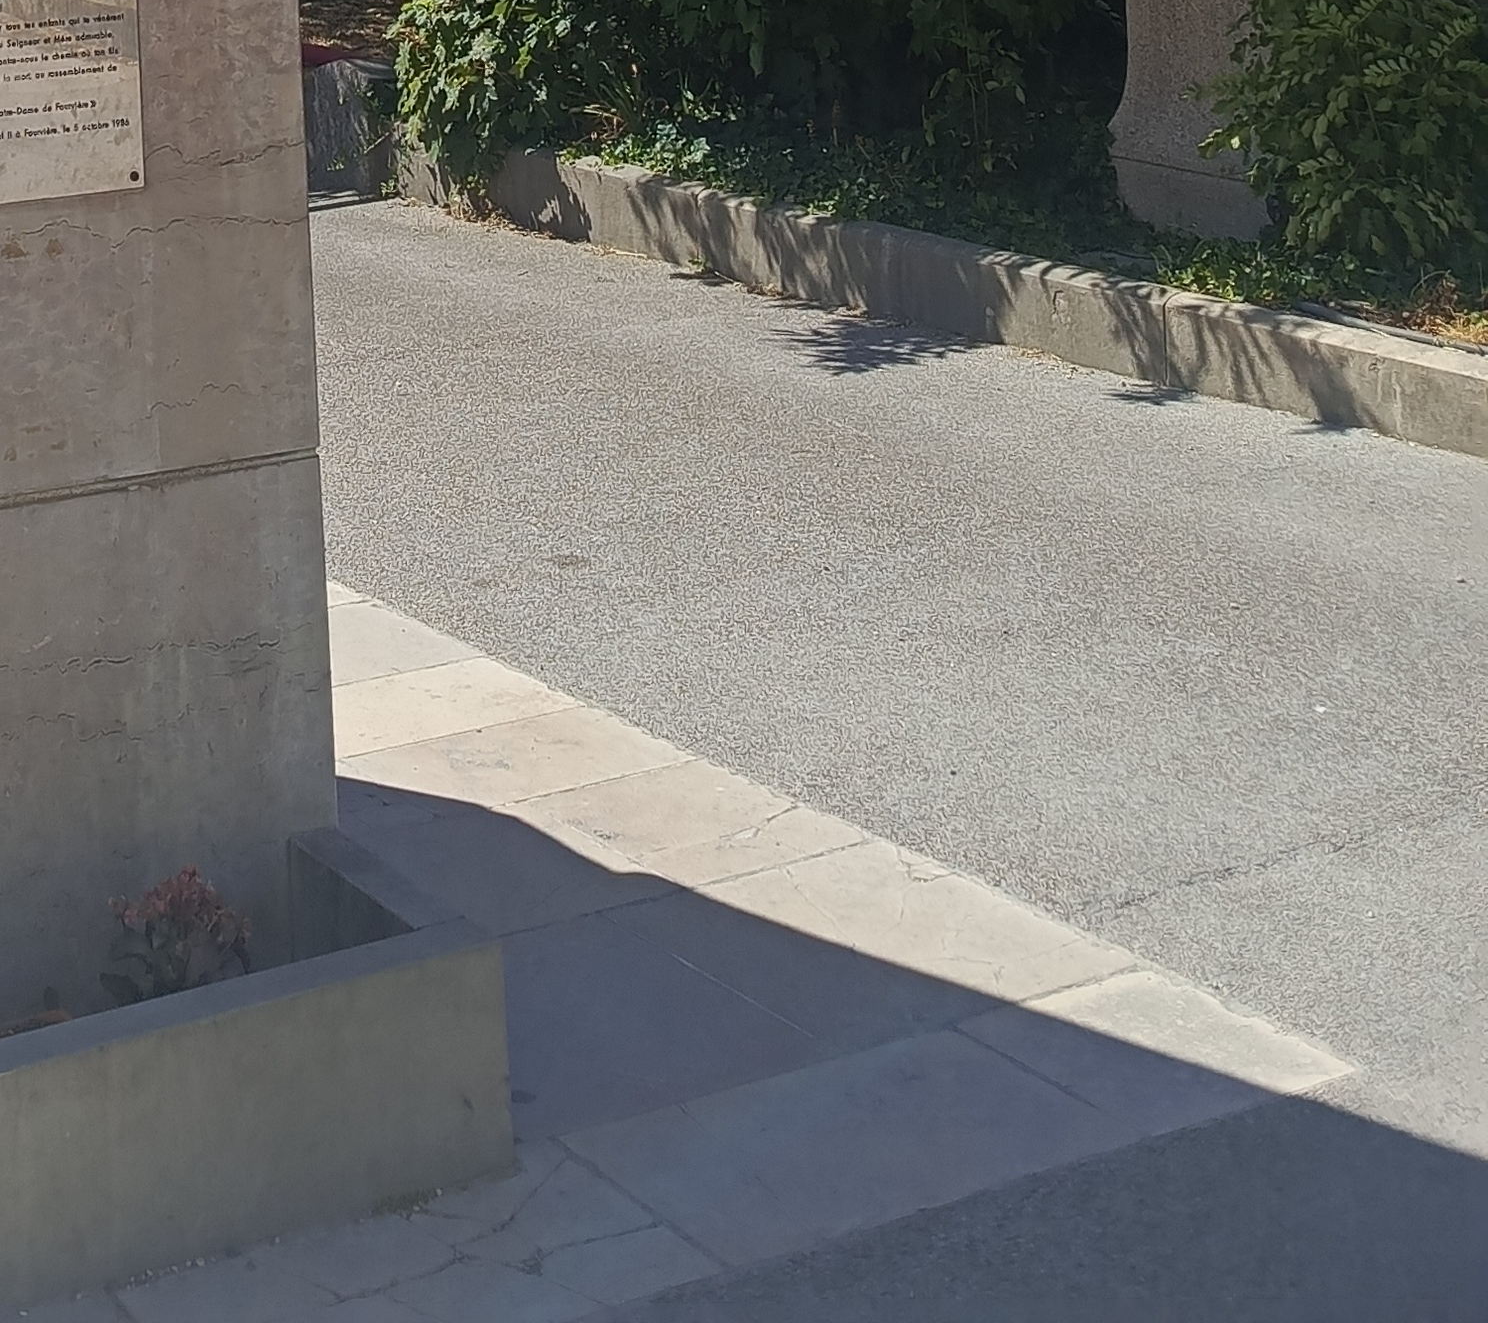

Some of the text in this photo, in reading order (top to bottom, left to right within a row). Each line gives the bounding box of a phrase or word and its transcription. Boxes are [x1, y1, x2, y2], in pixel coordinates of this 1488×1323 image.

[6, 23, 21, 31] tous
[39, 18, 65, 28] enfants
[69, 18, 80, 26] qui
[93, 13, 124, 23] vénèrent
[7, 38, 41, 49] Seigneur
[44, 37, 51, 45] et
[54, 35, 72, 44] Mère
[41, 53, 49, 61] le
[52, 51, 78, 60] chemin
[3, 73, 11, 82] la
[48, 65, 104, 78] rassemblement
[107, 64, 118, 73] de
[42, 104, 52, 113] de
[15, 130, 21, 138] à
[63, 124, 70, 133] le
[73, 123, 79, 132] 5
[82, 121, 109, 131] octobre
[112, 118, 130, 128] 1986
